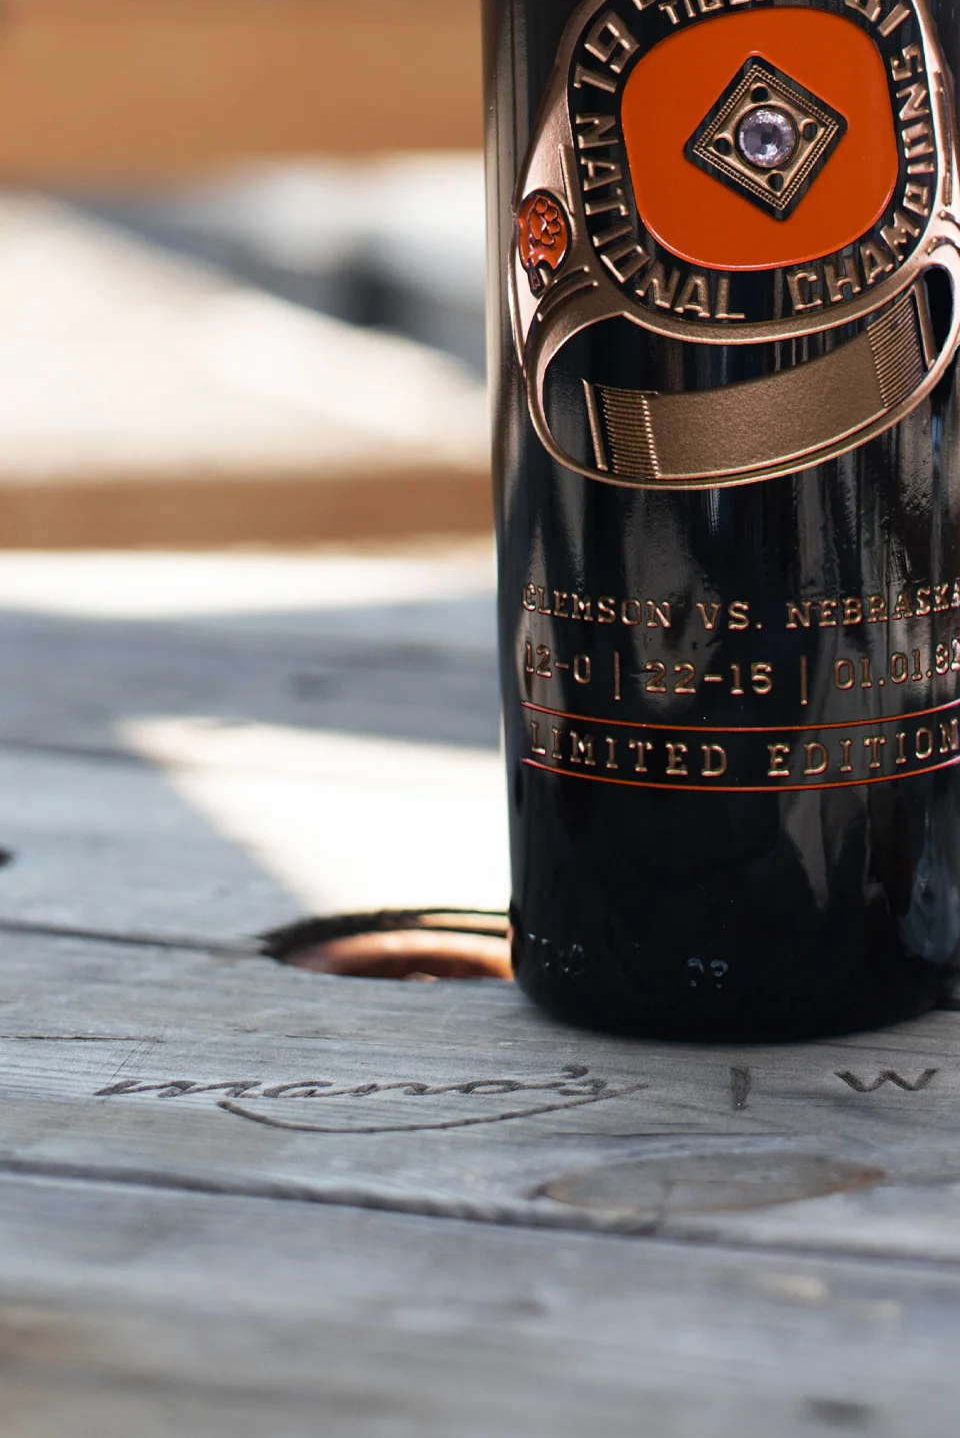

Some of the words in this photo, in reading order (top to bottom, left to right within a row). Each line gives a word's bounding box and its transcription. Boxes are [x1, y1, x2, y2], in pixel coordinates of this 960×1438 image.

[575, 112, 747, 320] NATIONAL
[786, 42, 936, 311] CHAMPIONS
[522, 582, 673, 629] CLEMSON
[695, 600, 763, 631] VS.
[525, 640, 592, 685] 12-0
[644, 660, 773, 696] 22-15
[530, 720, 729, 778] LIMITED
[766, 716, 960, 777] EDITION
